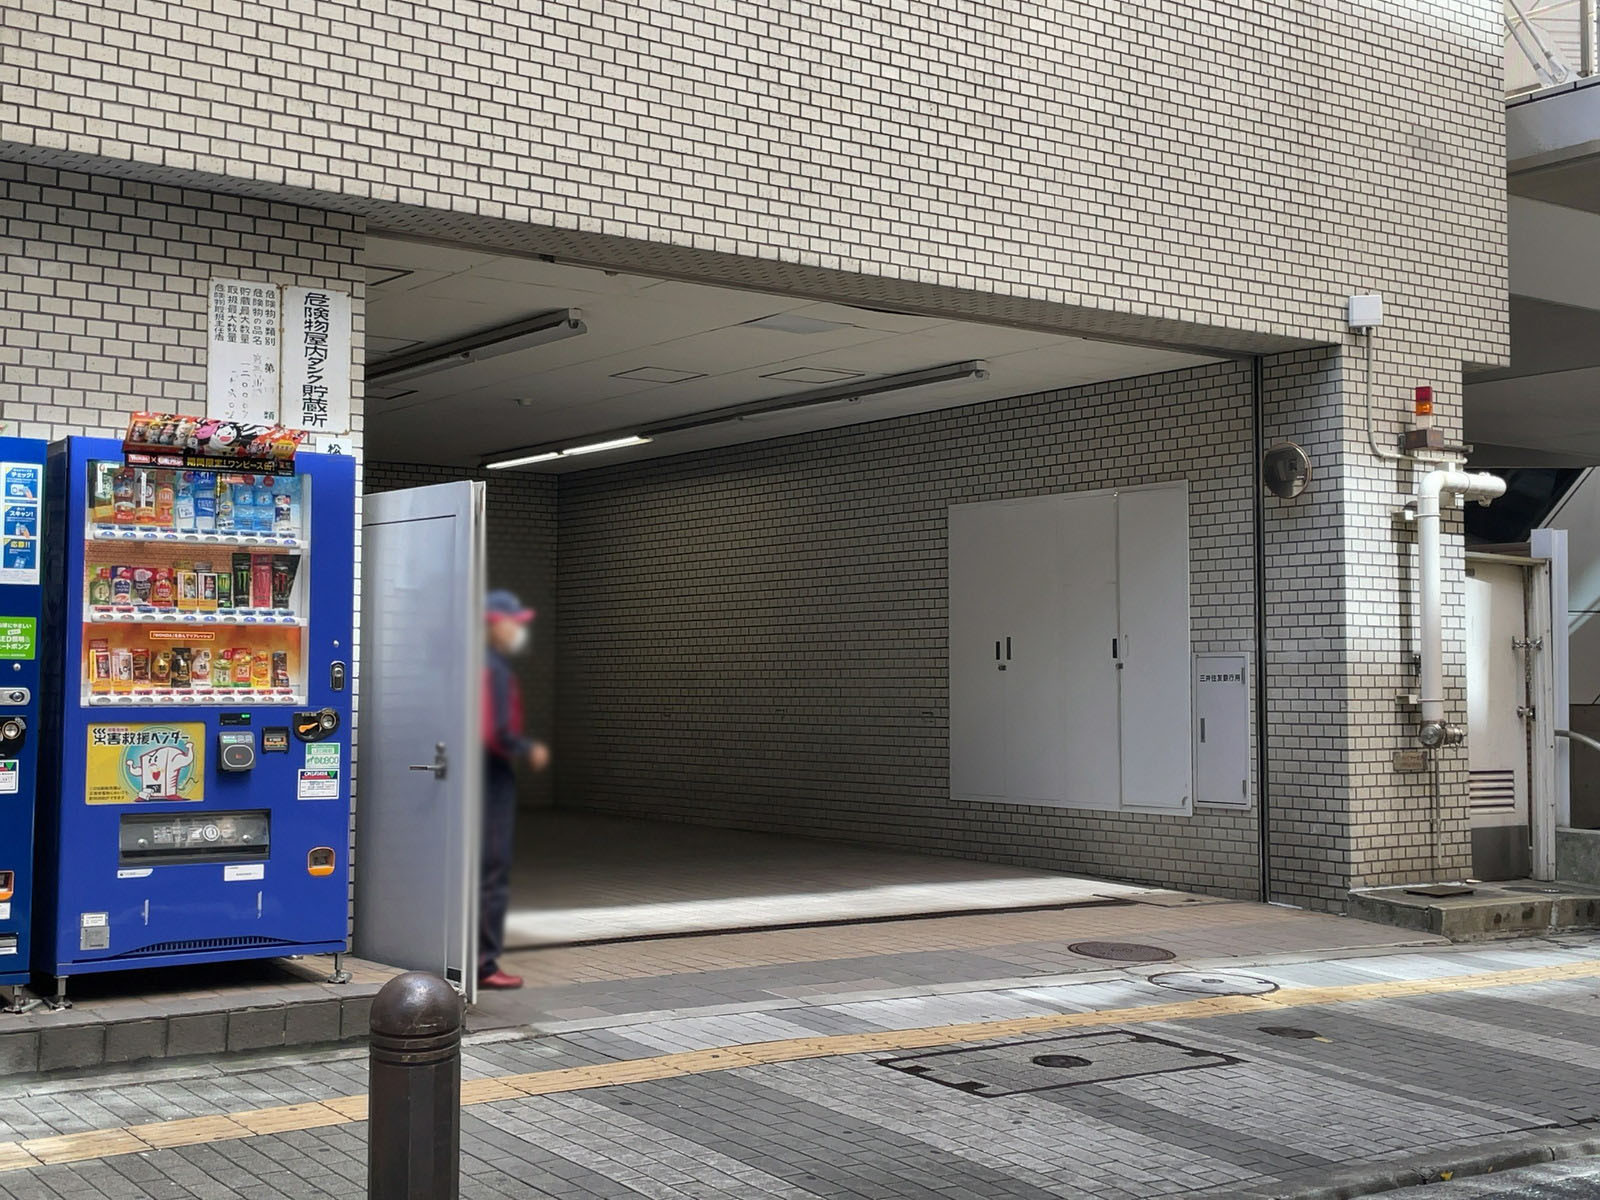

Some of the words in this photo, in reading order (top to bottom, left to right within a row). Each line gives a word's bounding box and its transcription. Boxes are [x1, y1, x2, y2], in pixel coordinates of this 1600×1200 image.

[227, 285, 238, 343] 取扱最大数量
[239, 287, 251, 344] 貯蔵最大数量
[252, 288, 263, 346] 危険物の品名
[264, 290, 276, 346] 危険物の類別
[302, 292, 330, 428] 危険物屋内タンク貯蔵所
[92, 727, 190, 745] 災害救援ベンダー
